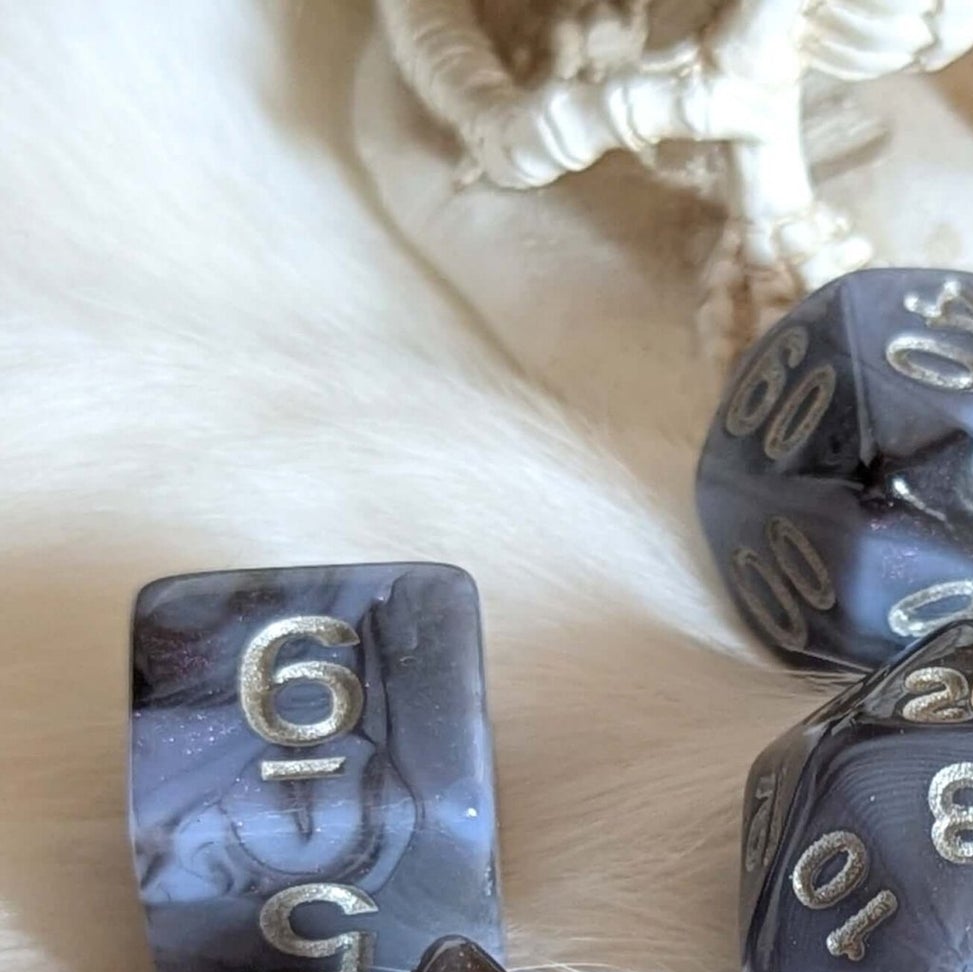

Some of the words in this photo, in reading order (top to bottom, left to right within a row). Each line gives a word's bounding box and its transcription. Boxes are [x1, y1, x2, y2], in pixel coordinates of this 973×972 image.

[731, 516, 835, 651] 00
[241, 615, 366, 780] 6
[792, 830, 897, 962] 10
